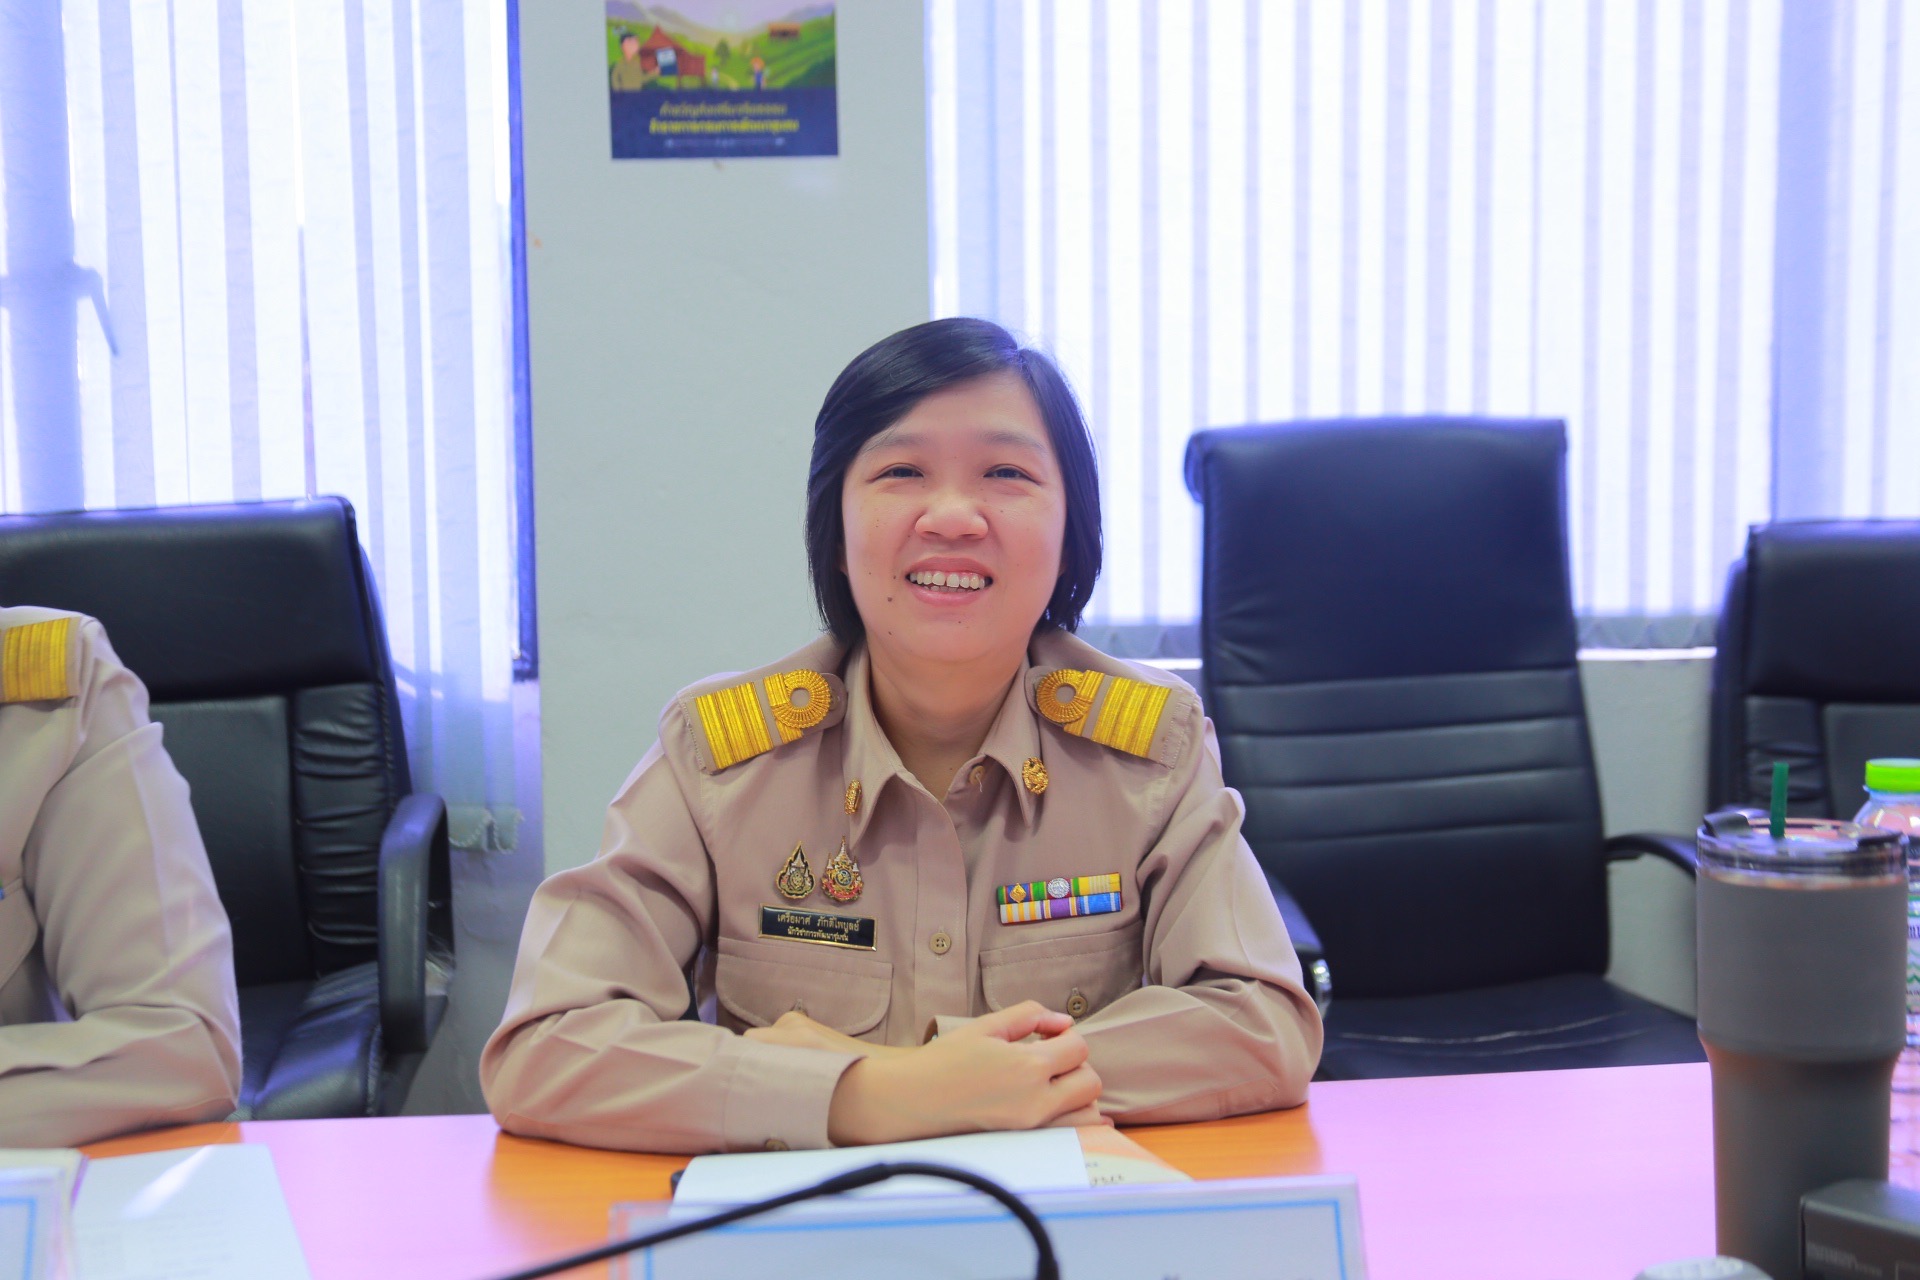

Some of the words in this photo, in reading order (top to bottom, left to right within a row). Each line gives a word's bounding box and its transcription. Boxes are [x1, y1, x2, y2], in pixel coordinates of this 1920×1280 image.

[787, 926, 849, 941] นักวิชาการพัฒนาชุมชน
